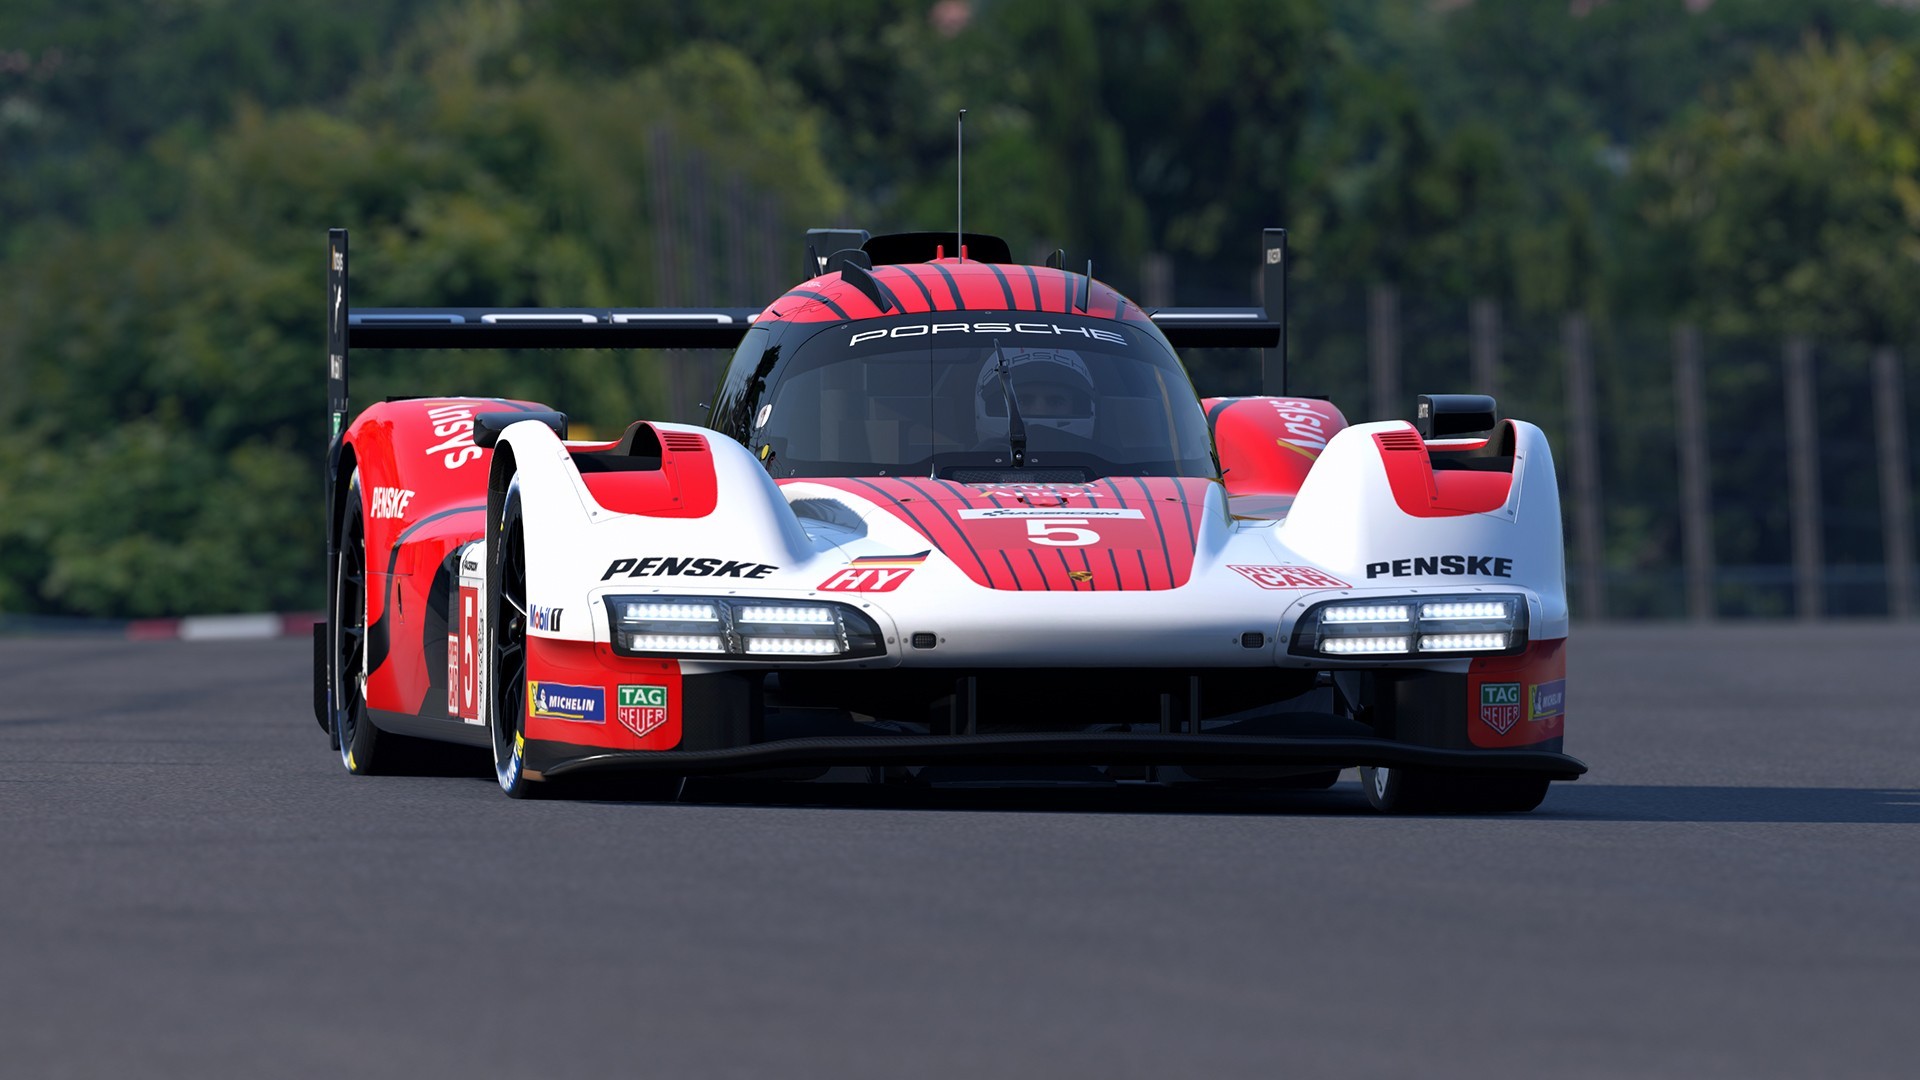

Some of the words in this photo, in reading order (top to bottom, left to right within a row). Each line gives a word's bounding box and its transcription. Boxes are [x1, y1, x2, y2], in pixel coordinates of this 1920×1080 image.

[850, 322, 1128, 347] PORSCHE
[370, 487, 416, 519] PENSKE
[1026, 519, 1101, 546] 5
[600, 557, 780, 582] PENSKE
[824, 569, 911, 590] HY
[1236, 566, 1319, 575] HYPER
[1366, 555, 1513, 579] PENSKE
[1252, 573, 1342, 587] CAR
[530, 603, 550, 631] Mobil
[464, 596, 473, 709] 5
[548, 695, 595, 712] MICHELIN
[622, 688, 662, 705] TAG
[1485, 686, 1517, 703] TAG
[620, 708, 664, 733] HEUER
[1484, 706, 1518, 731] HEUER
